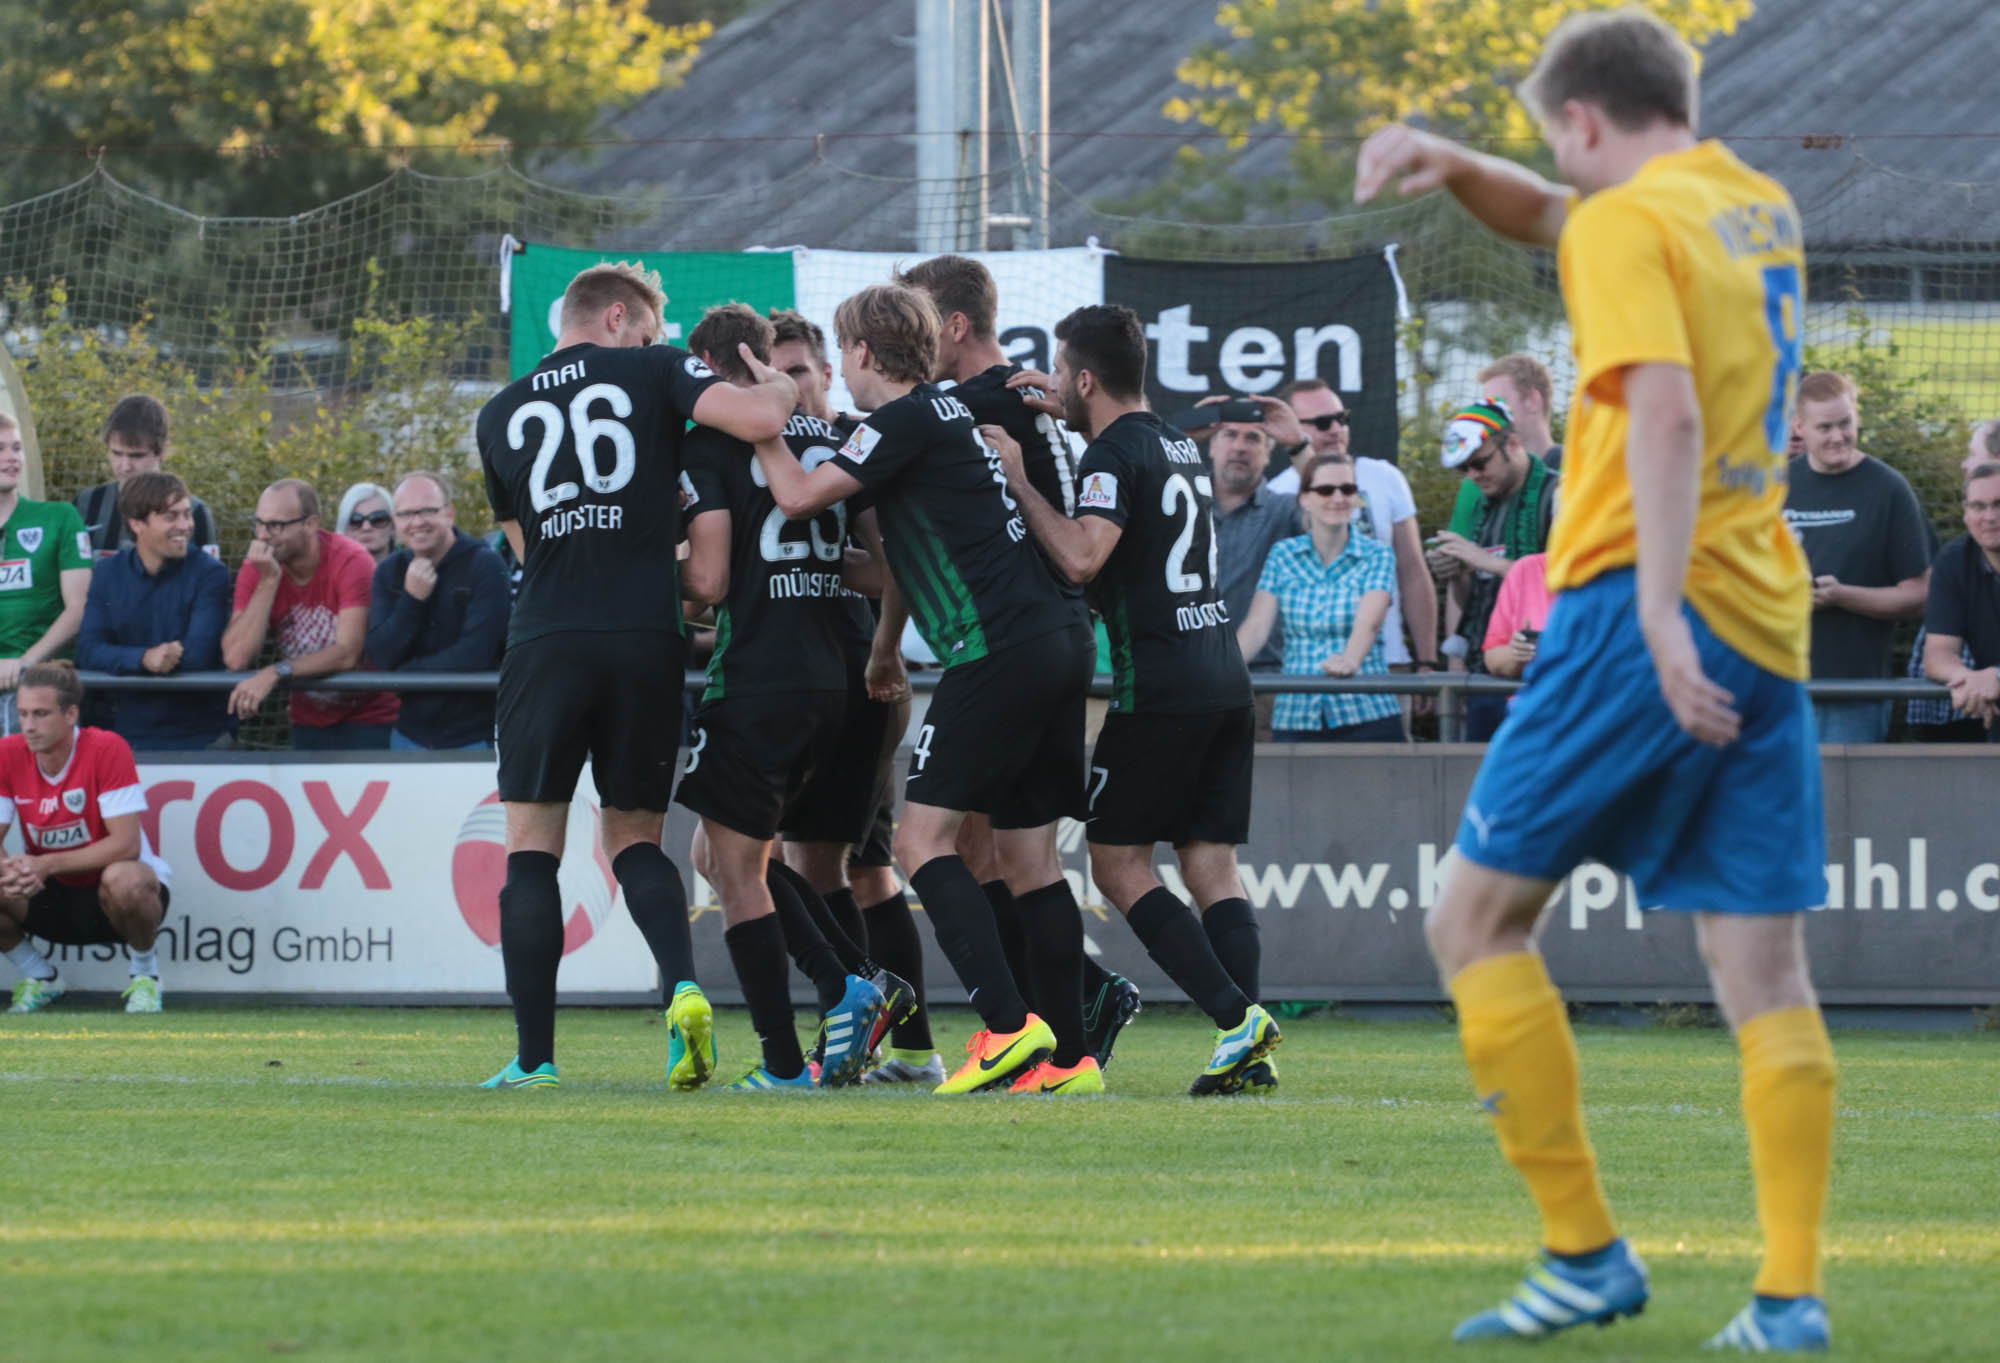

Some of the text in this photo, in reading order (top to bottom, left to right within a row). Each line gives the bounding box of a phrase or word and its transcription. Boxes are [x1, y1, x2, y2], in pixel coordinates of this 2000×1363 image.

[532, 360, 586, 391] MAI
[507, 383, 636, 514] 26
[273, 927, 393, 963] GmbH
